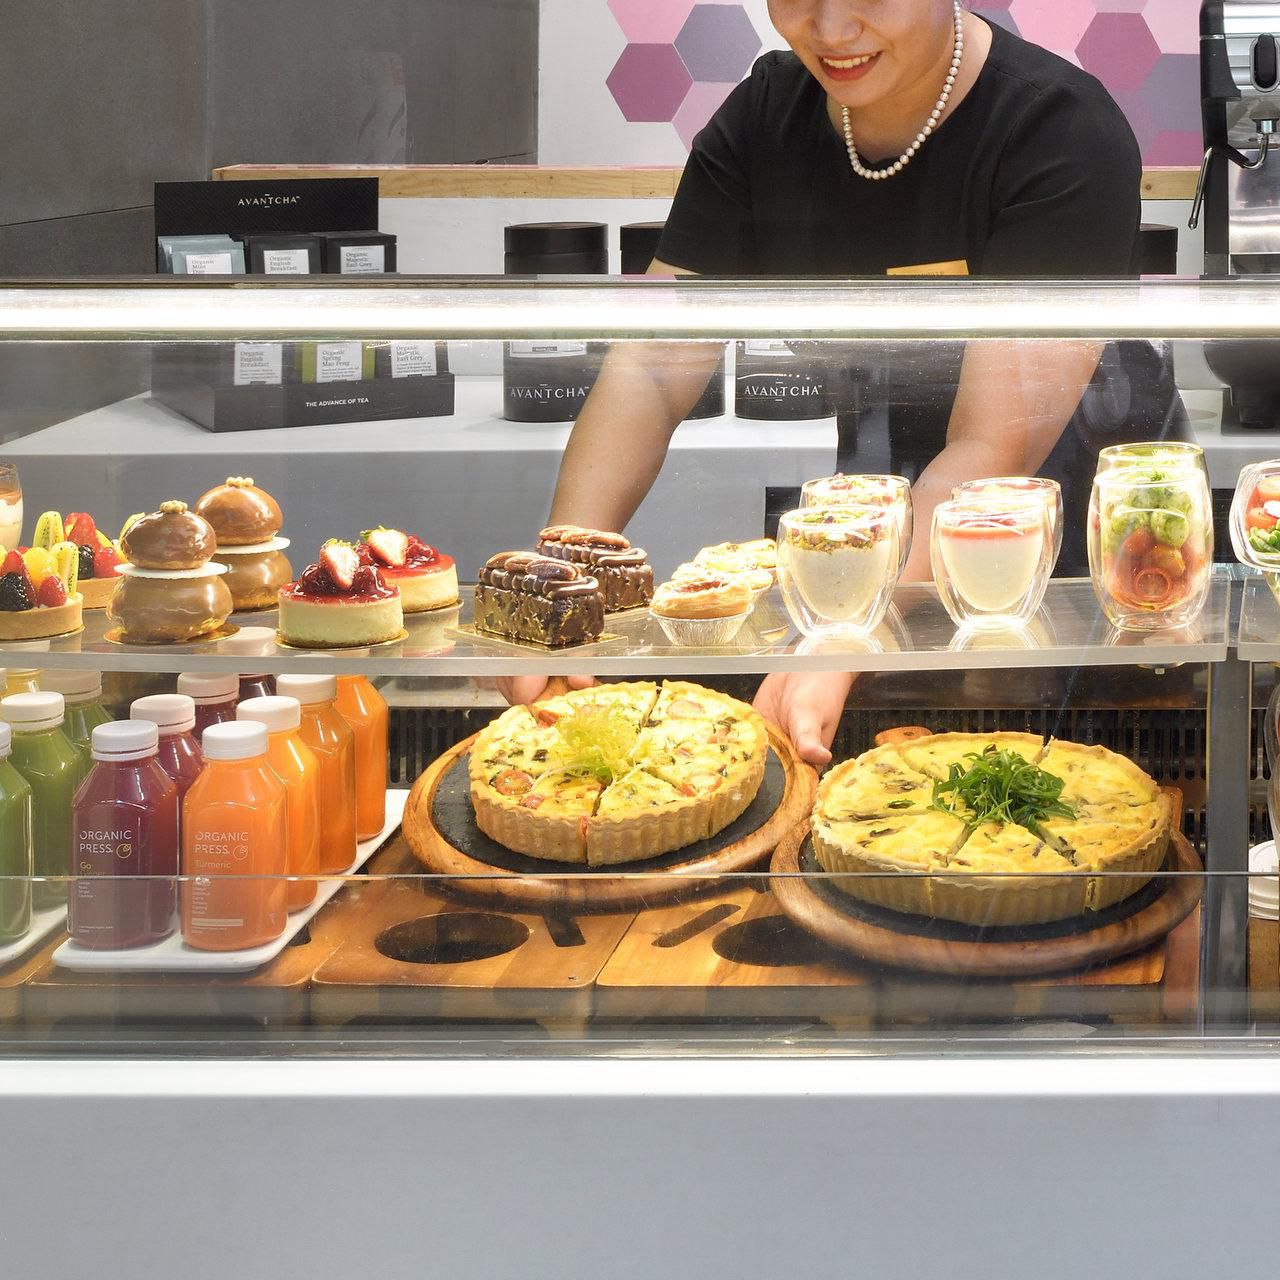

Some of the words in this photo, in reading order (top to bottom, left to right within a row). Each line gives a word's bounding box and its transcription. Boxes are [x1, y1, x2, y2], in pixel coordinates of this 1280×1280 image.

[319, 399, 347, 407] ADVANCE
[80, 830, 132, 840] ORGANIC
[195, 832, 249, 842] ORGANIC
[80, 862, 92, 870] Go
